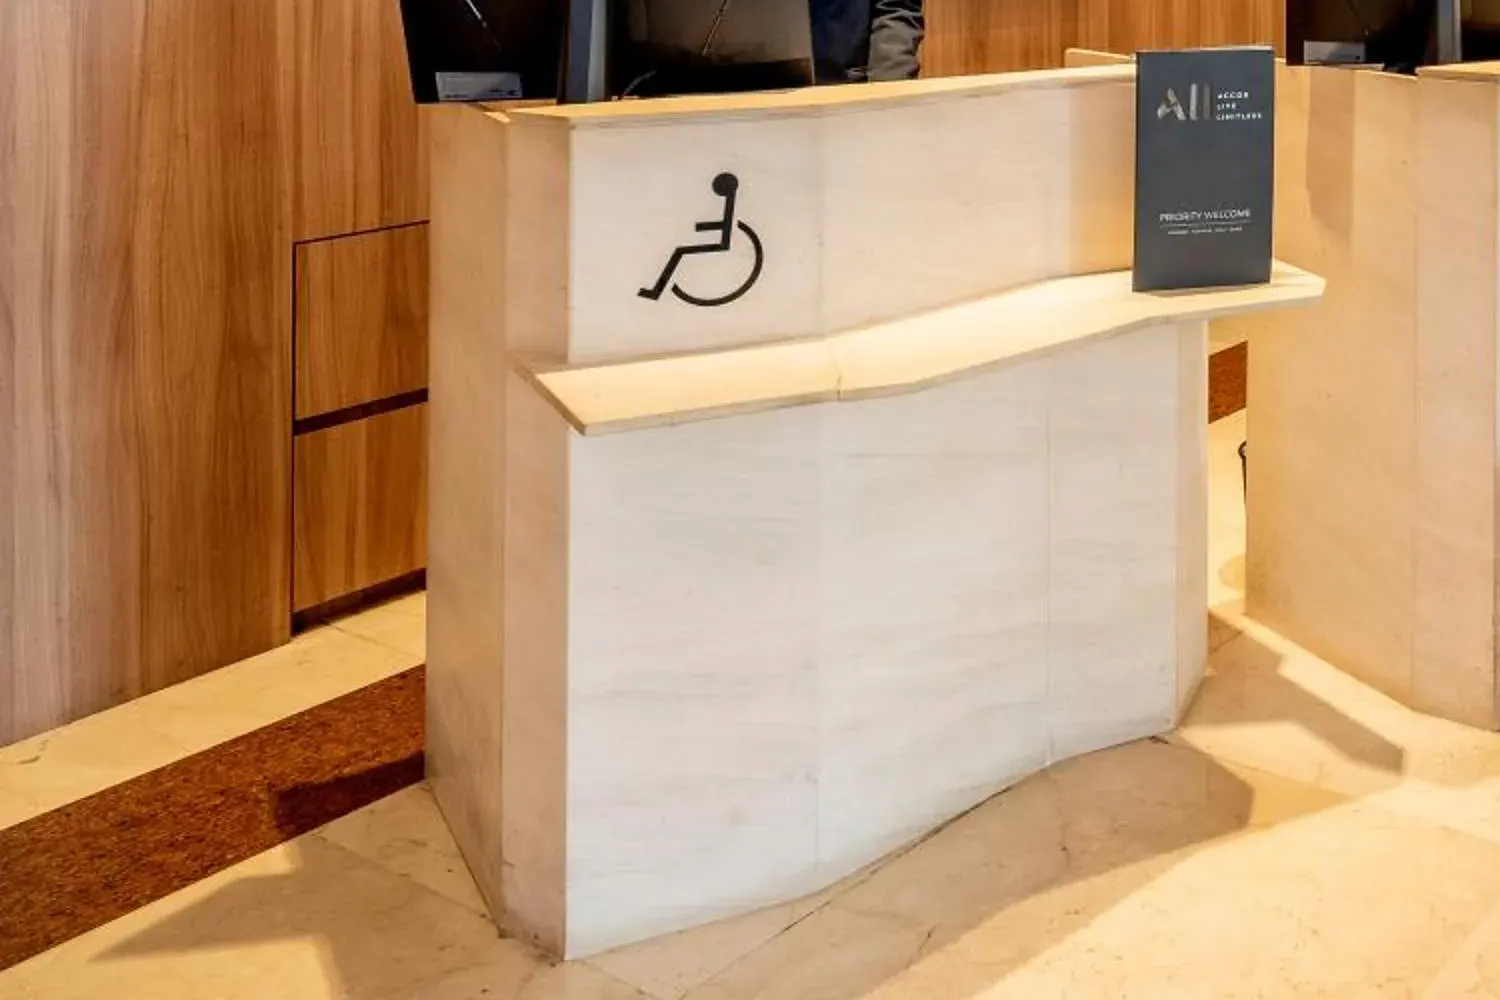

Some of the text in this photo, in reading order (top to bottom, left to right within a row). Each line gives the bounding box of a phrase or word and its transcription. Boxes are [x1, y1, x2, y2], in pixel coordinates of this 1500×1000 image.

[1217, 91, 1249, 99] ACCOR
[1159, 208, 1251, 222] PRIORITY WELCOME
